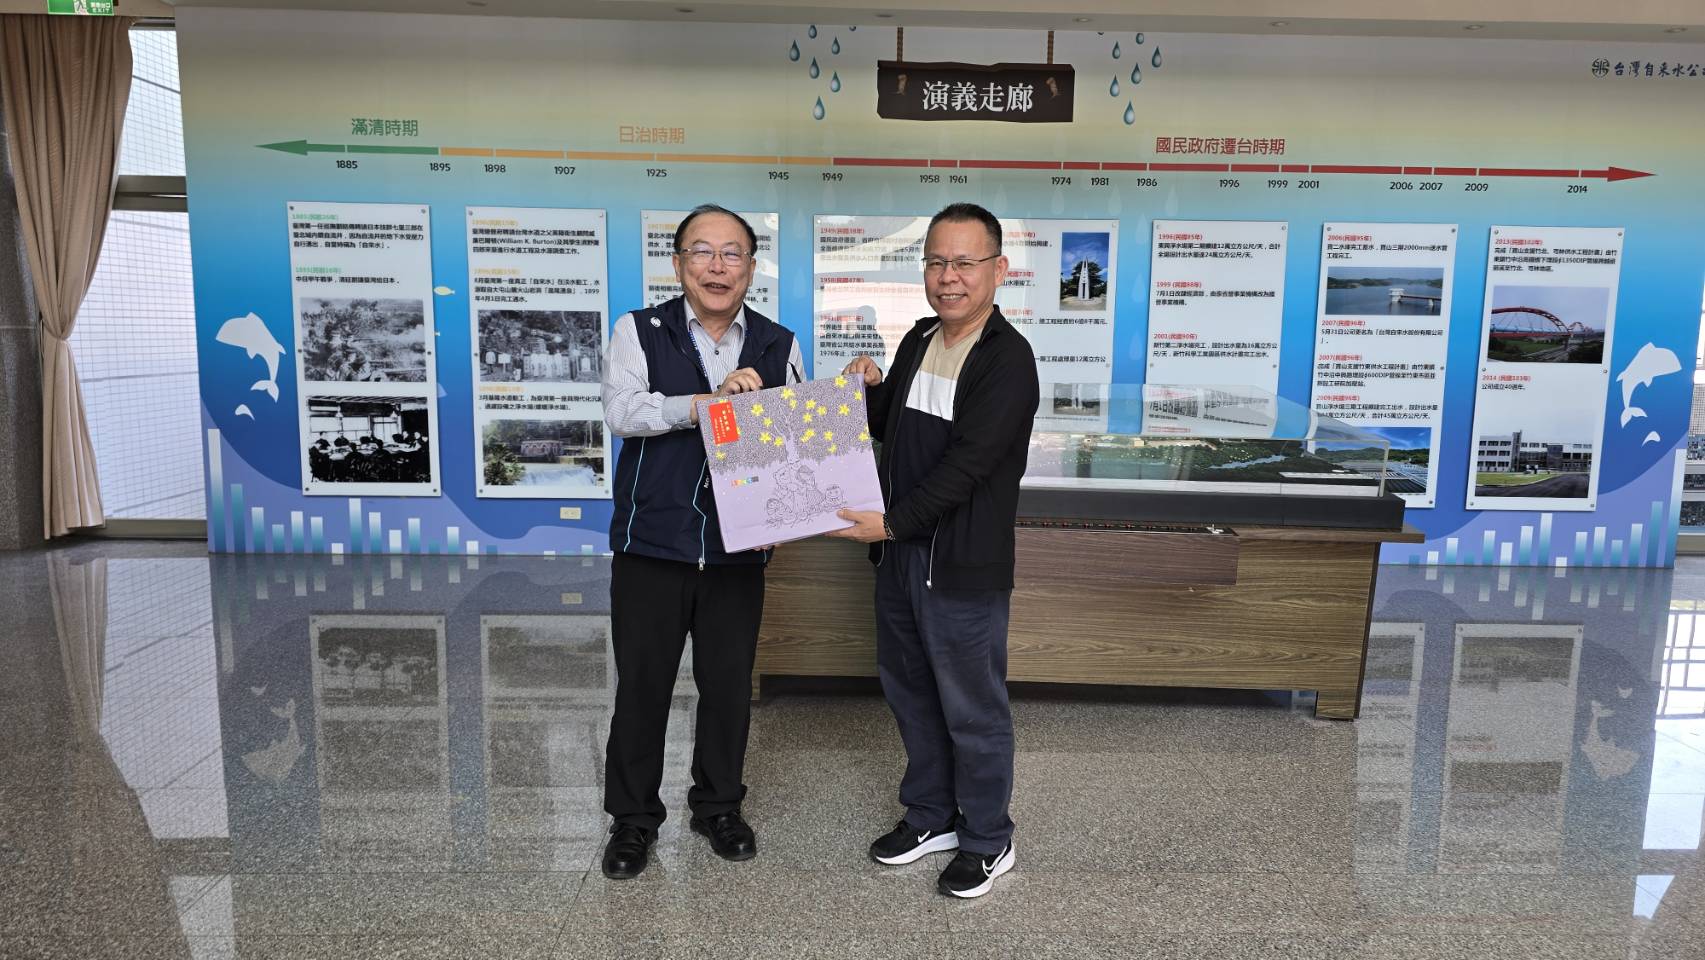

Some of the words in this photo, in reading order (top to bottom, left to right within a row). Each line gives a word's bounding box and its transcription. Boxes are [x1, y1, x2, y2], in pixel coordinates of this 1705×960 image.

[922, 81, 1034, 113] 演義走廊
[351, 118, 418, 137] 滿清時期
[619, 126, 685, 144] 日治時期
[1155, 137, 1286, 155] 國民政府遷台時期
[336, 160, 358, 169] 1885
[429, 162, 451, 172] 1895
[484, 164, 506, 173] 1898
[554, 166, 576, 175] 1907
[646, 168, 667, 177] 1925
[768, 171, 789, 180] 1945
[822, 172, 843, 181] 1949
[919, 174, 940, 184] 1958
[949, 175, 968, 184] 1961
[1051, 176, 1072, 186] 1974
[1091, 177, 1109, 186] 1981
[1137, 178, 1158, 187] 1986
[1219, 179, 1240, 188] 1996
[1268, 180, 1288, 189] 1999
[1298, 180, 1320, 189] 2001
[1390, 181, 1413, 190] 2006
[1419, 182, 1443, 191] 2007
[1464, 183, 1489, 192] 2009
[1567, 184, 1588, 194] 2014
